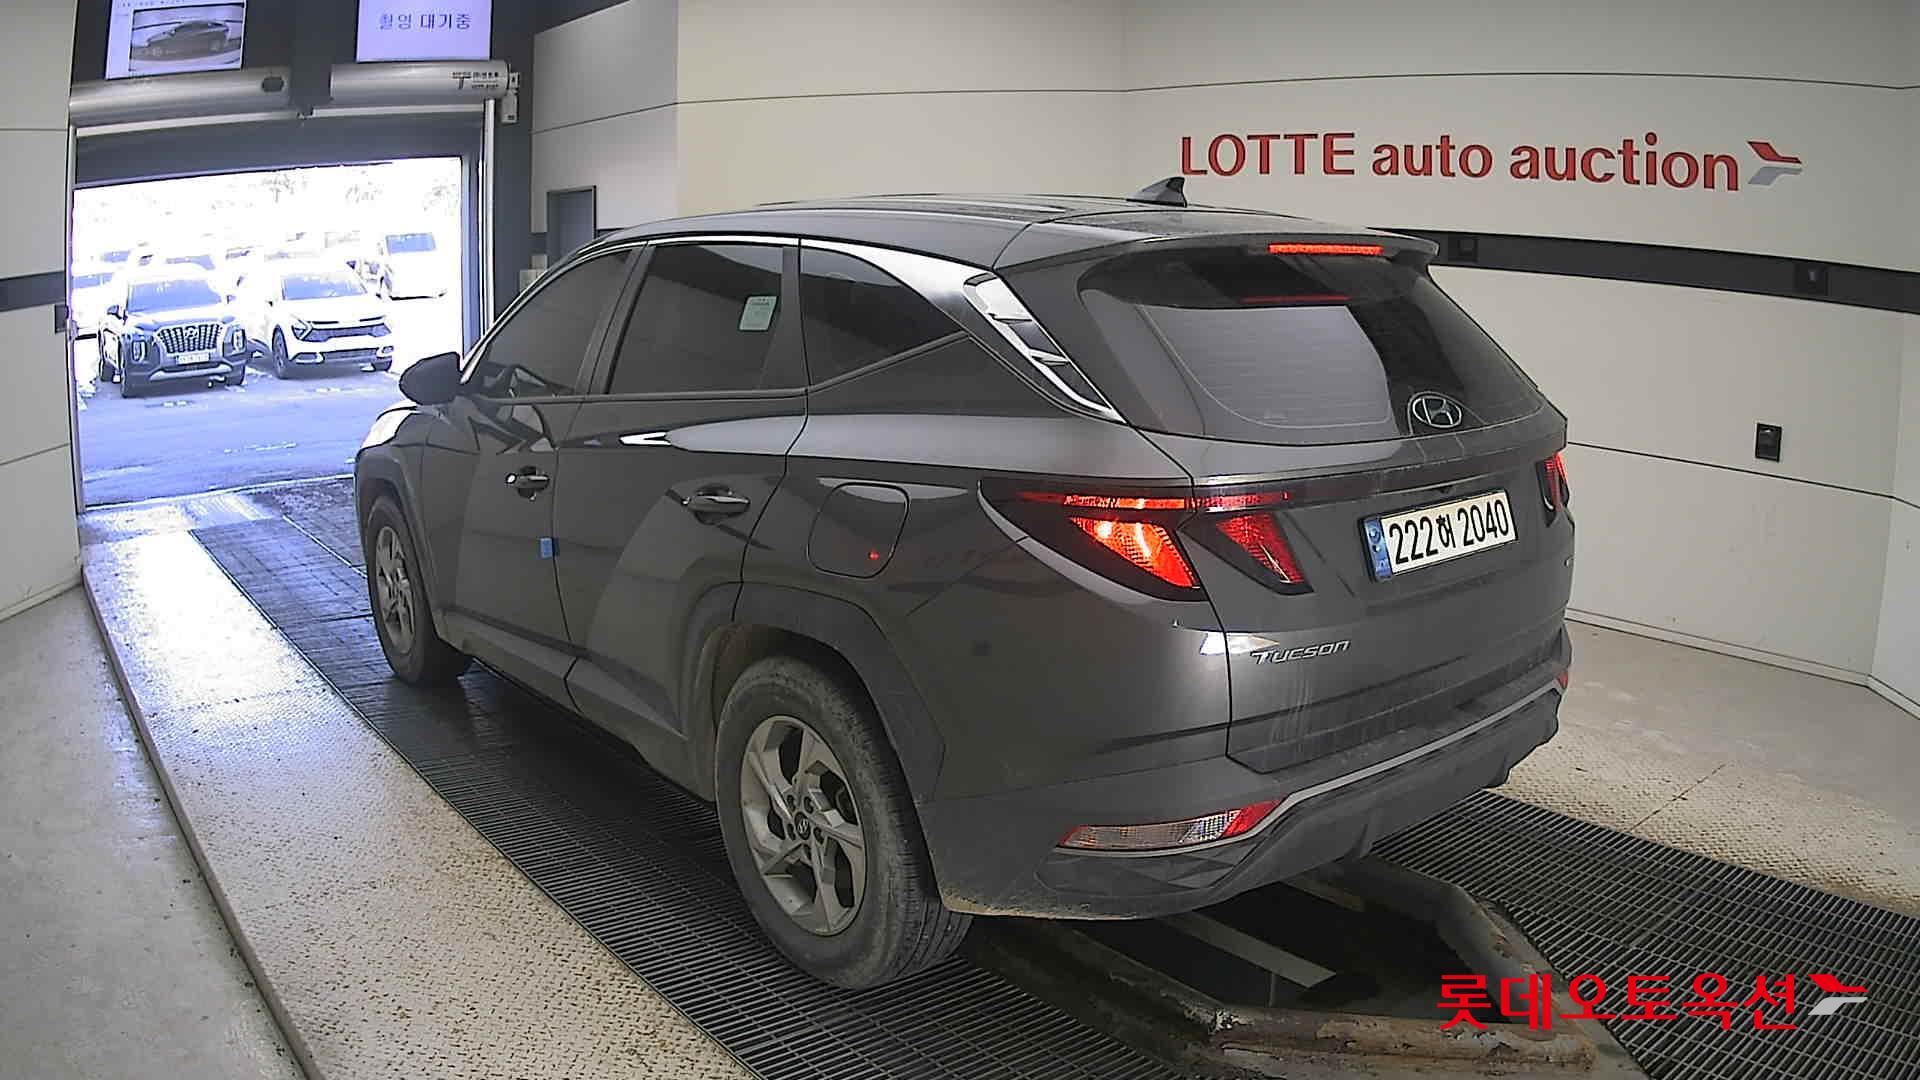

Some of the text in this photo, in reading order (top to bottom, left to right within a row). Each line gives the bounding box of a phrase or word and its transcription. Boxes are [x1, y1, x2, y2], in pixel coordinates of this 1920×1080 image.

[419, 12, 472, 31] 대기중
[1180, 132, 1740, 191] LOTTE auto auction
[1388, 498, 1510, 565] 222허 2040
